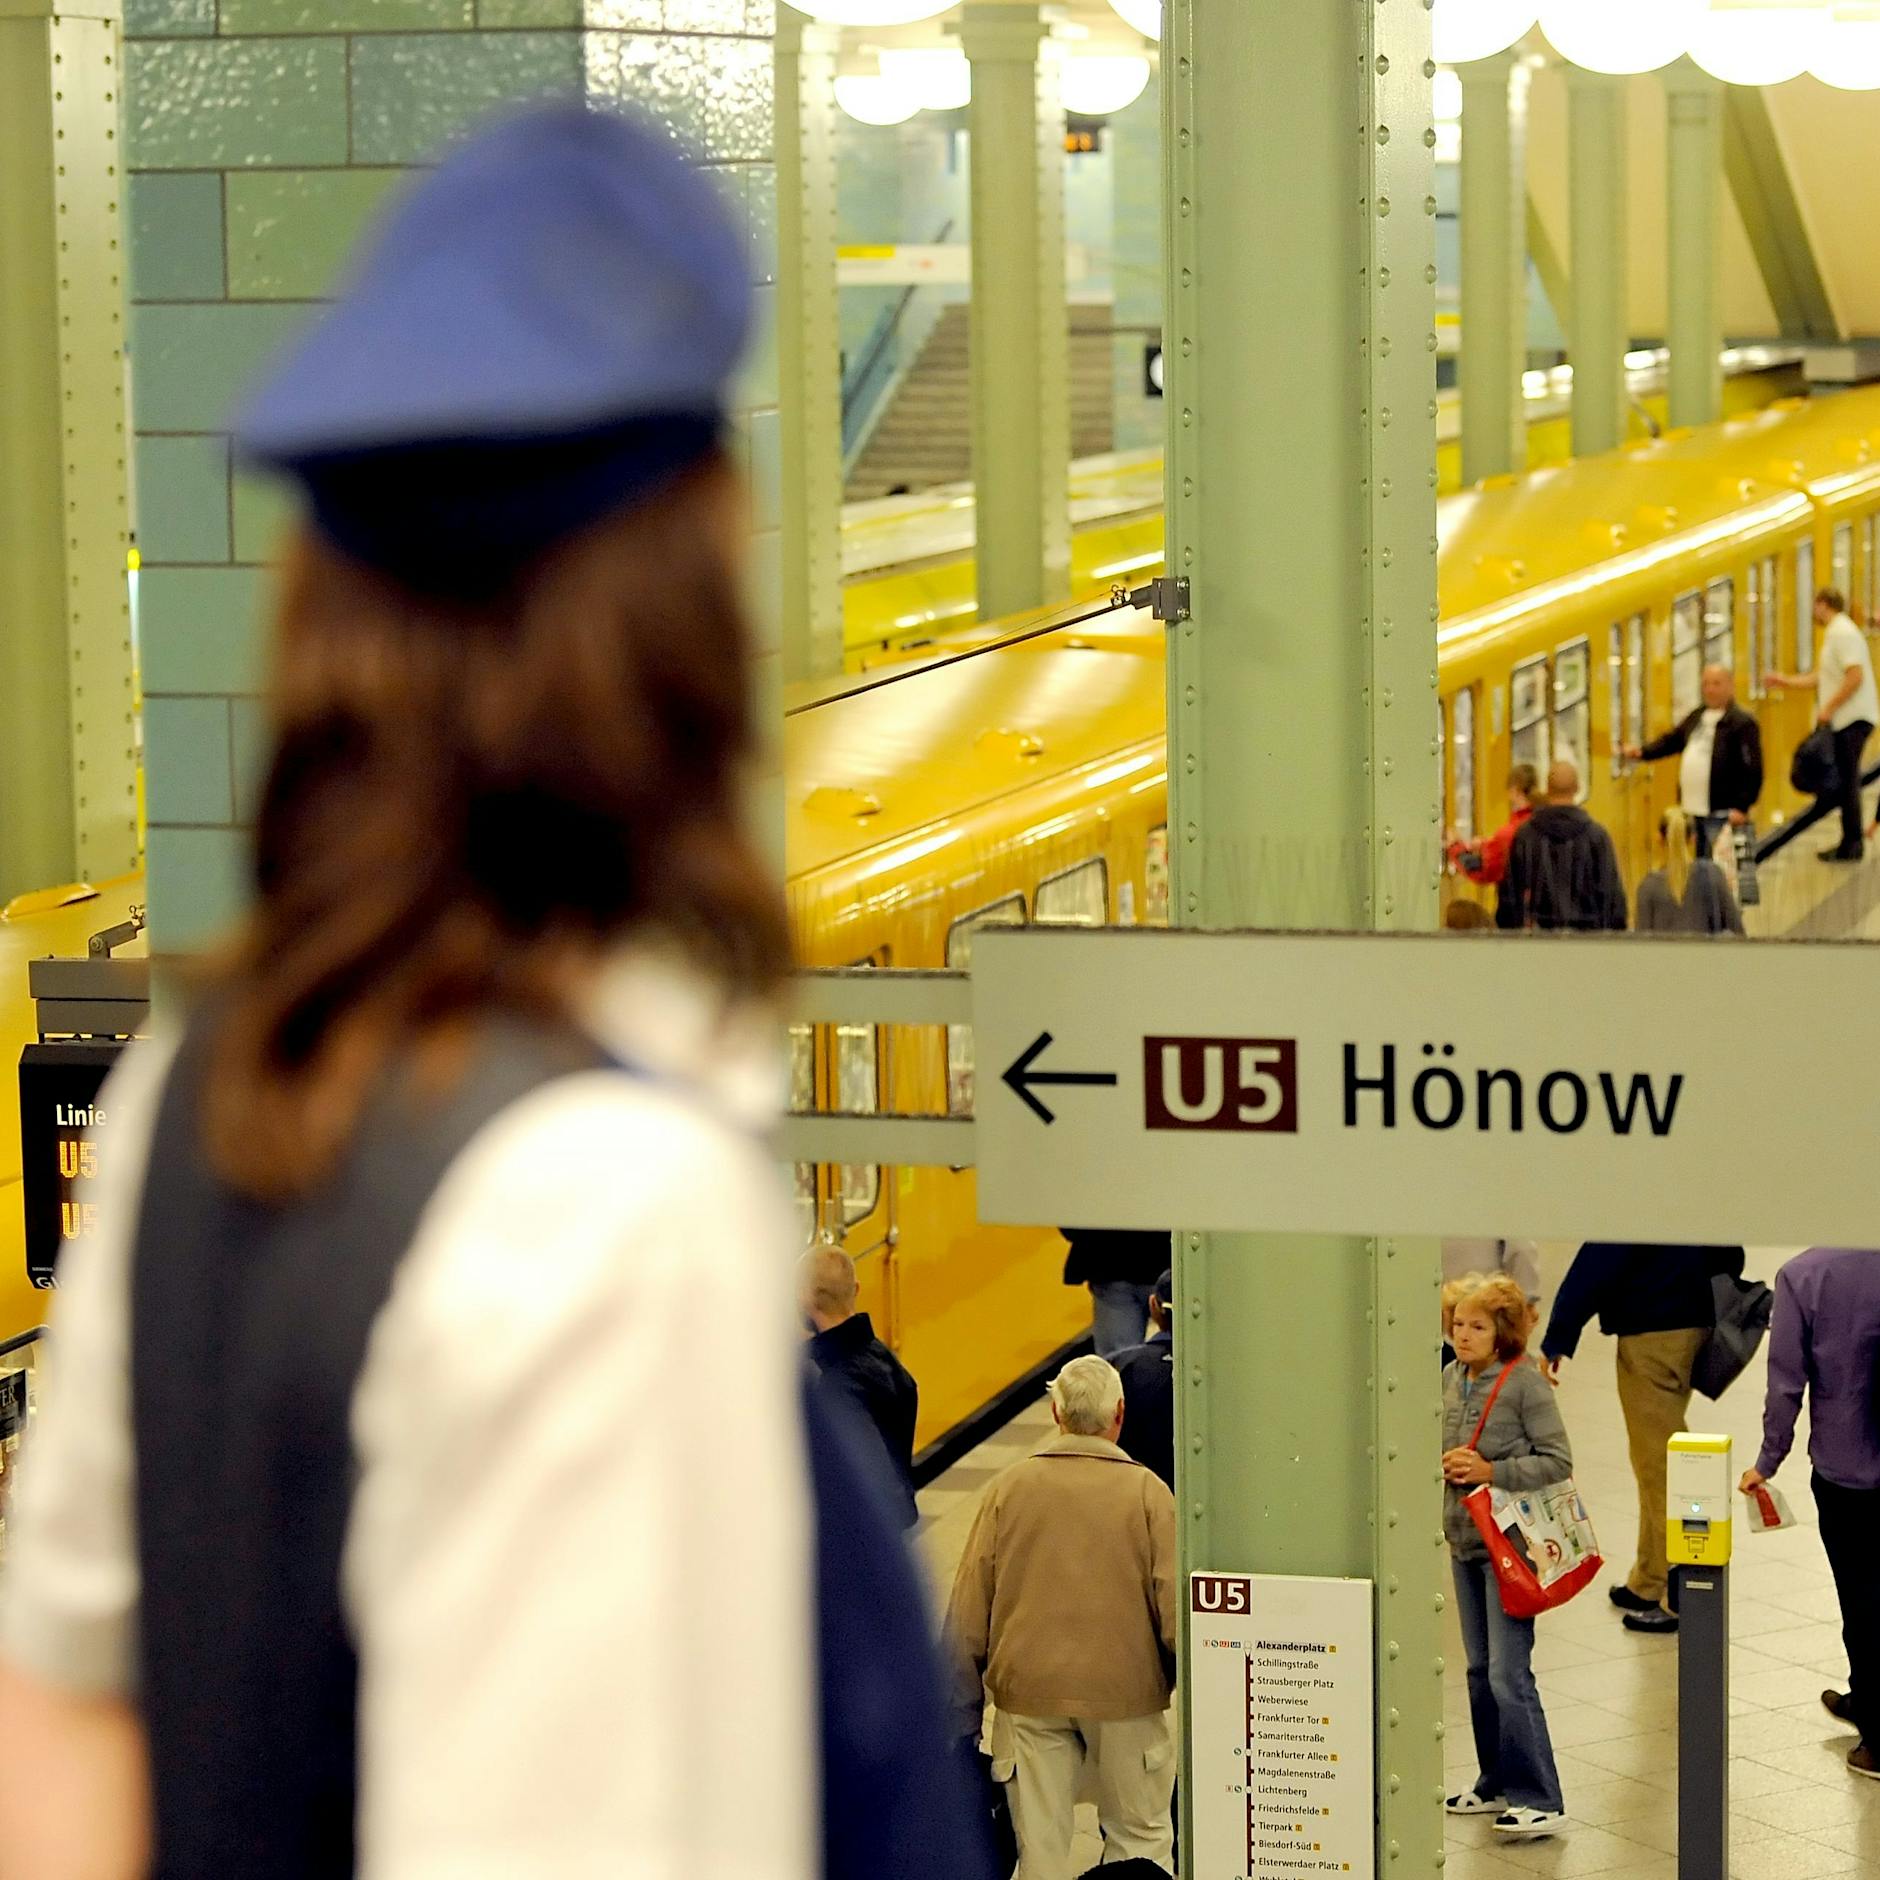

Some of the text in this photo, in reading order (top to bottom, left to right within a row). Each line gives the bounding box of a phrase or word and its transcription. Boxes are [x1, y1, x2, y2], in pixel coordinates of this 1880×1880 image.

[1160, 1042, 1685, 1137] U5 Hönow
[56, 1103, 107, 1126] Linie
[59, 1141, 98, 1179] U5
[1198, 1580, 1246, 1611] U5
[1256, 1641, 1326, 1653] Alexanderplatz
[1257, 1658, 1318, 1670] Schillingstraße
[1257, 1676, 1334, 1689] Strausberger Platz
[1258, 1695, 1308, 1706] Weberwiese
[1258, 1713, 1319, 1724] Frankfurter Tor
[1258, 1731, 1324, 1743] Samariterstraße
[1258, 1749, 1328, 1761] Frankfurter Allee
[1258, 1767, 1335, 1779] Magdalenenstraße
[1258, 1785, 1307, 1798] Lichtenberg
[1259, 1804, 1319, 1815] Friedrichsfelde
[1259, 1822, 1293, 1832] Tierpark
[1259, 1840, 1311, 1851] Biesdorf-Süd
[1259, 1857, 1339, 1870] Elsterwerdaer Platz
